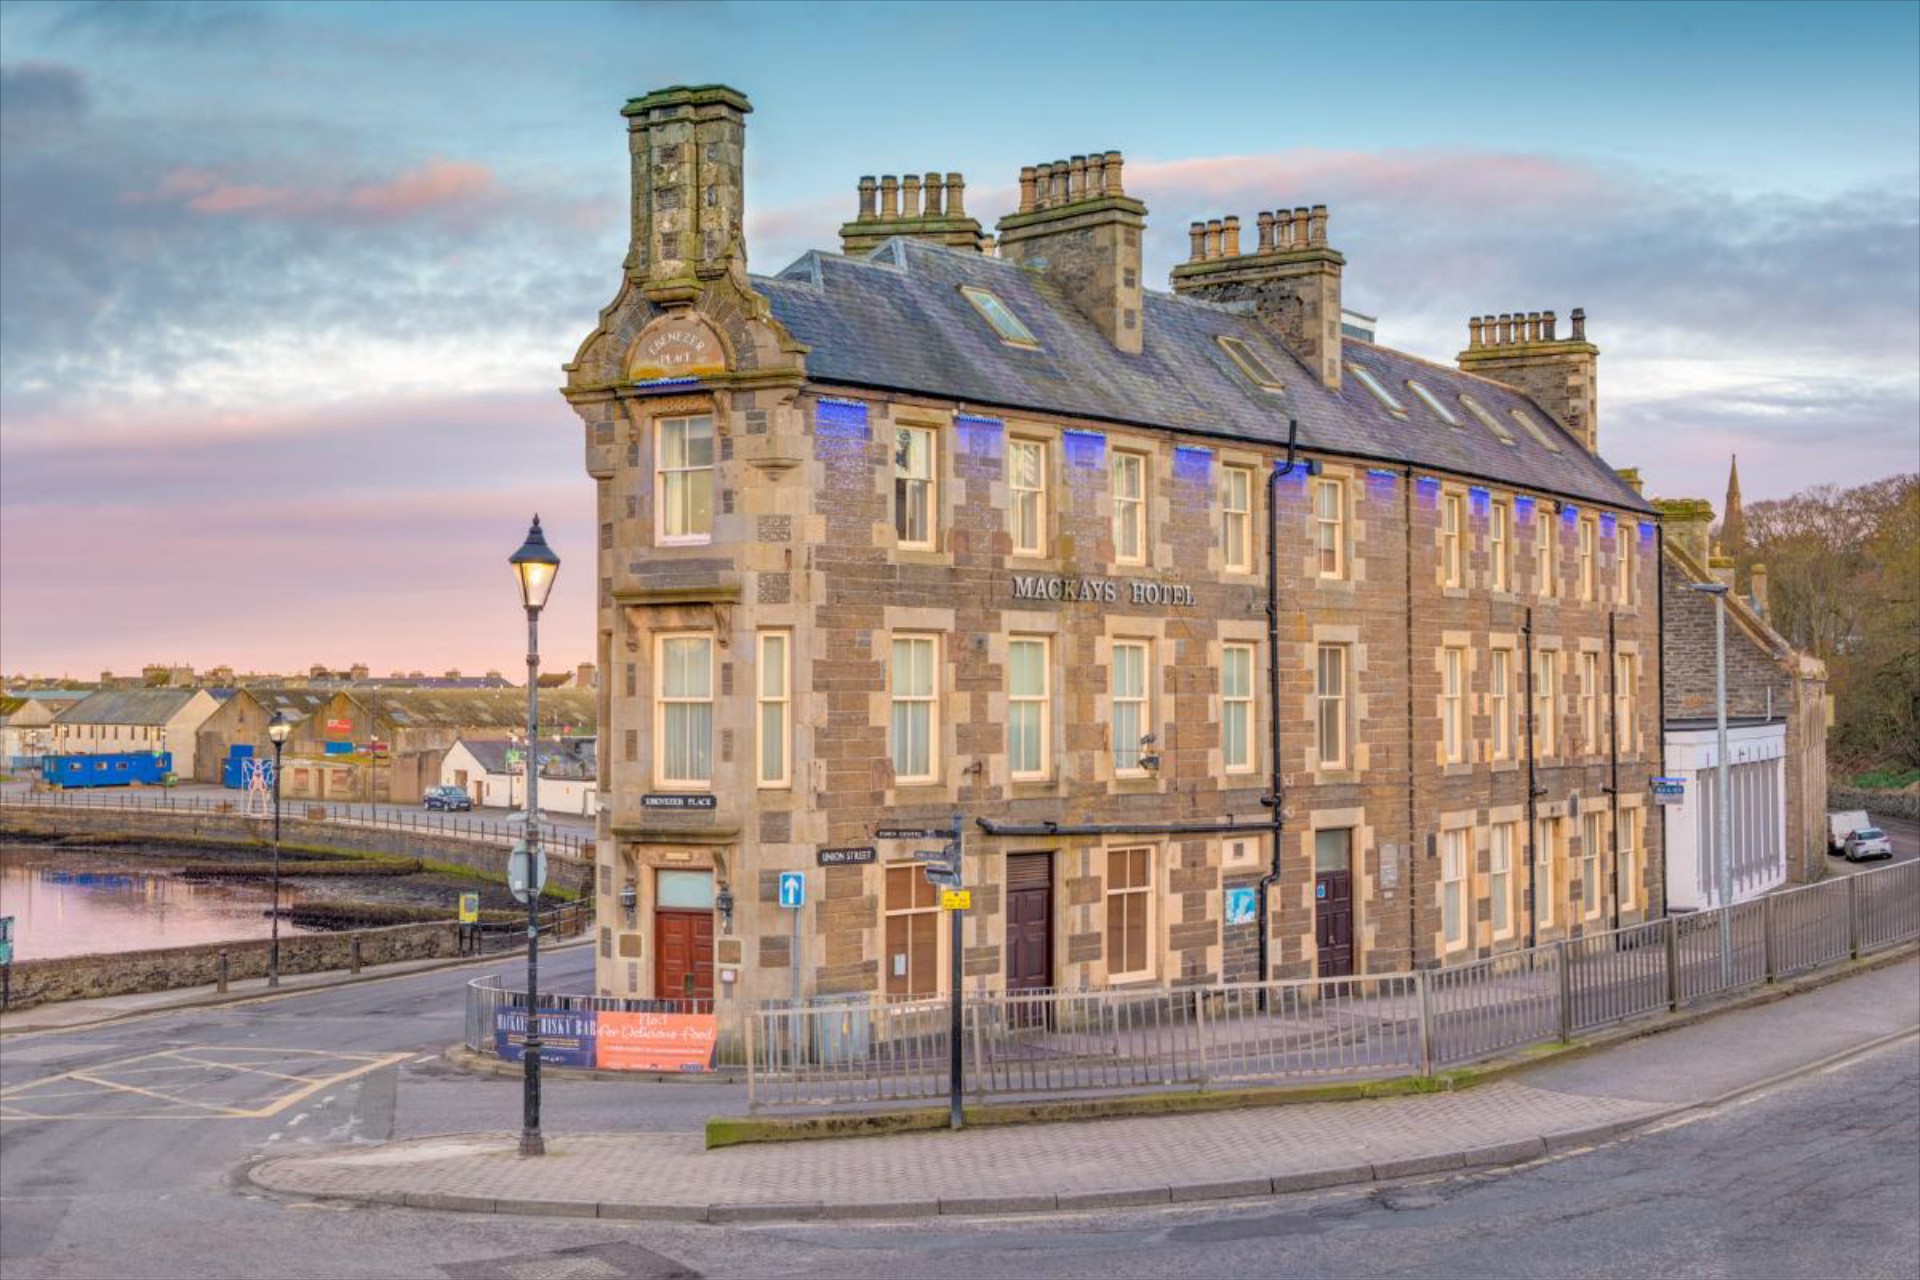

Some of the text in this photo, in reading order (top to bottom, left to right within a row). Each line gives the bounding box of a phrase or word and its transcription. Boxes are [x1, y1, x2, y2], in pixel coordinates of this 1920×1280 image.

[648, 331, 705, 356] EBENEZER
[660, 352, 690, 364] PLACE
[1013, 576, 1197, 606] MACKAYS HOTEL
[687, 797, 711, 806] PLACE
[822, 850, 872, 863] UNION STREET
